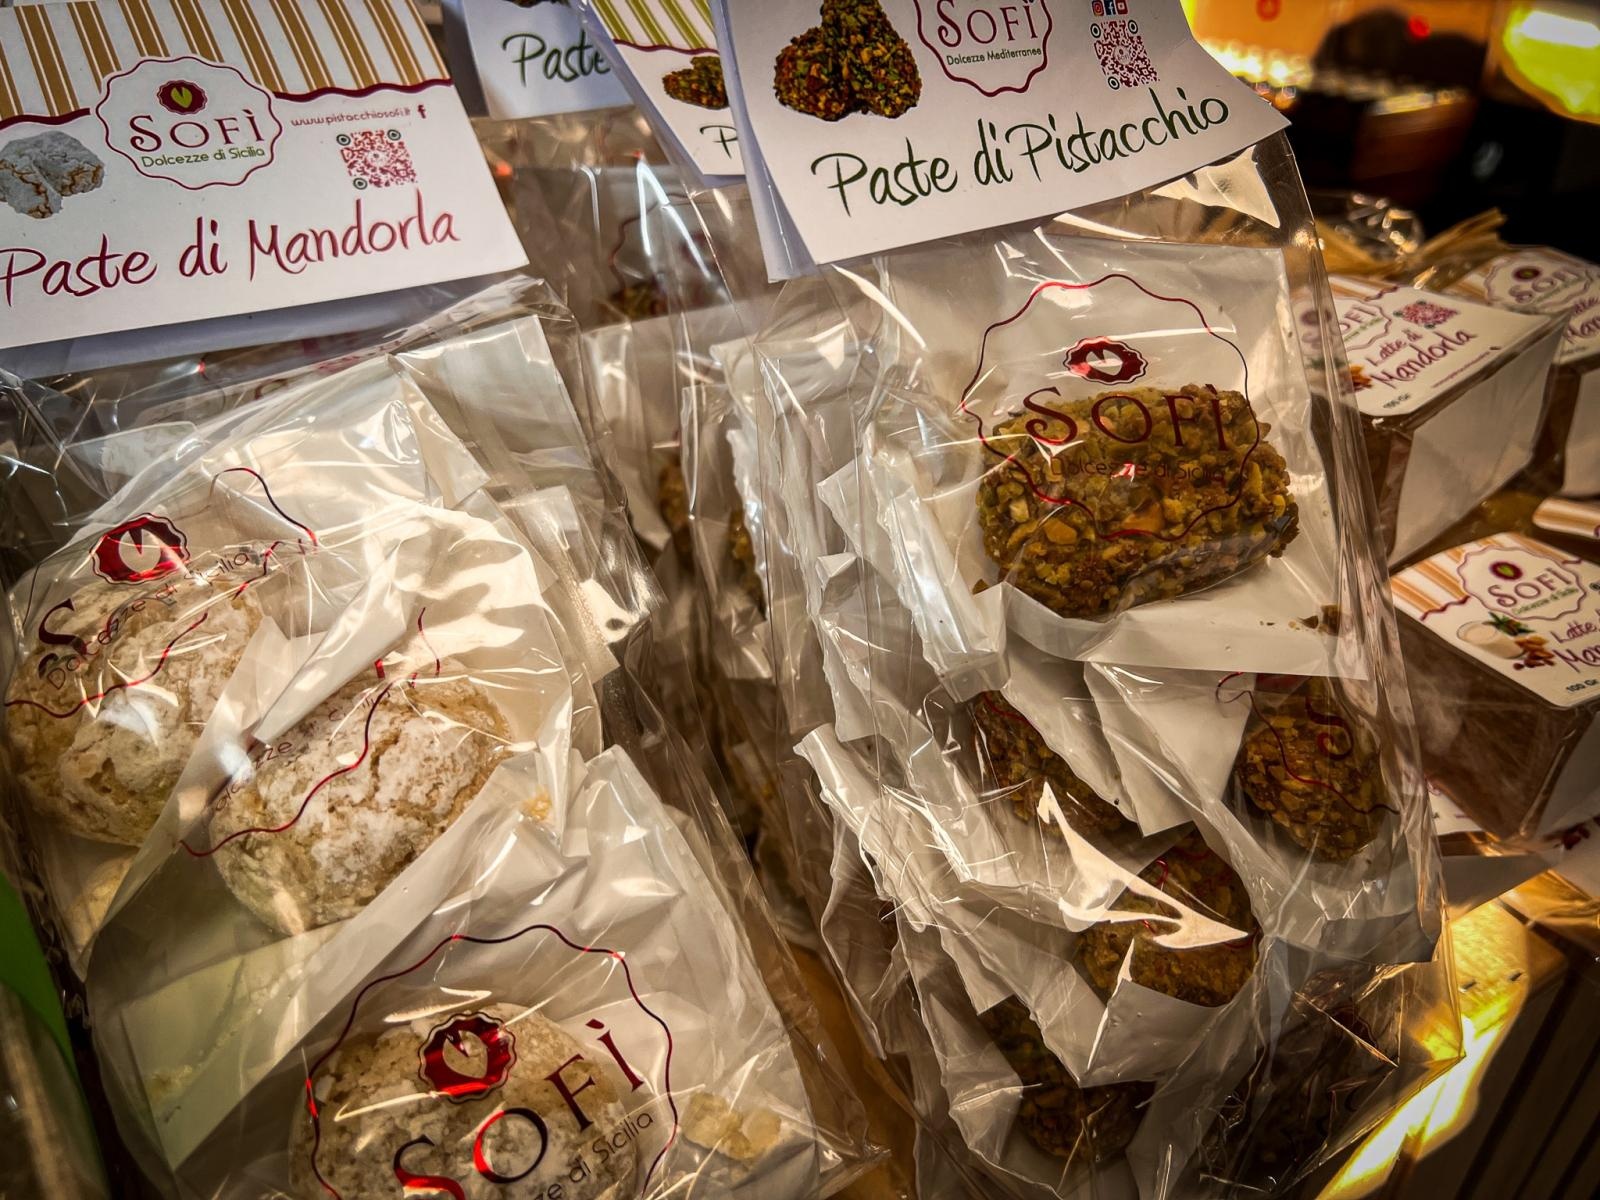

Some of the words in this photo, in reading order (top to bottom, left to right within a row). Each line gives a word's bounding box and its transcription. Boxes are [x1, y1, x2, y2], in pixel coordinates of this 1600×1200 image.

[946, 53, 986, 66] Dolcezze
[987, 47, 1042, 61] Mediterranee
[129, 108, 265, 152] SOFÌ
[811, 136, 958, 217] Paste
[972, 117, 1013, 187] di
[1004, 86, 1230, 184] Pistacchio
[141, 153, 209, 168] Dolcezze
[213, 149, 227, 160] di
[228, 145, 265, 159] Sicilia
[0, 233, 158, 307] Paste
[178, 216, 228, 278] di
[247, 186, 462, 283] Mandorla
[1364, 337, 1407, 367] Latte
[1370, 329, 1479, 389] Mandorla
[1550, 620, 1598, 643] Latte
[592, 1112, 653, 1164] Sicilia
